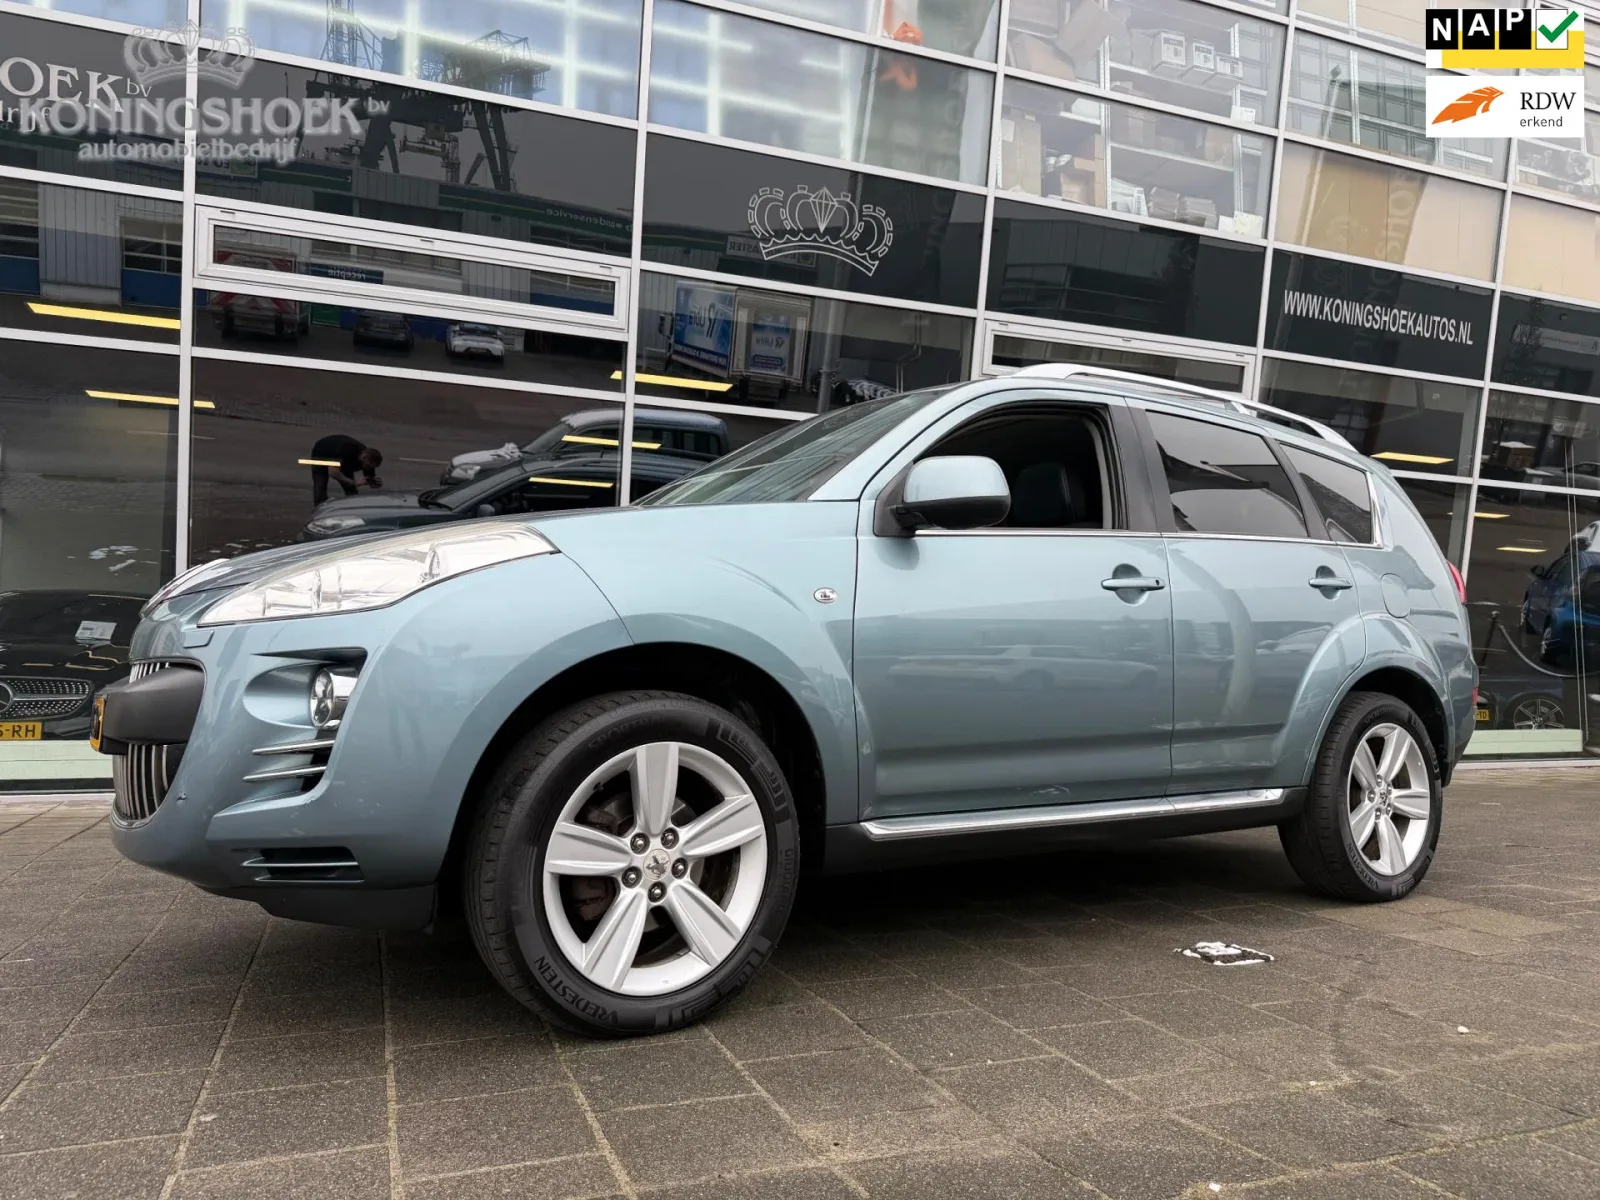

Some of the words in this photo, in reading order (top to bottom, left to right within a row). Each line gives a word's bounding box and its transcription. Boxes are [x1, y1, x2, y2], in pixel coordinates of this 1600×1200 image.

[126, 77, 152, 98] bv
[1284, 289, 1474, 345] WWW.KONINGSHOEKAUTOS.NL
[534, 956, 619, 1025] VREDESTEIN
